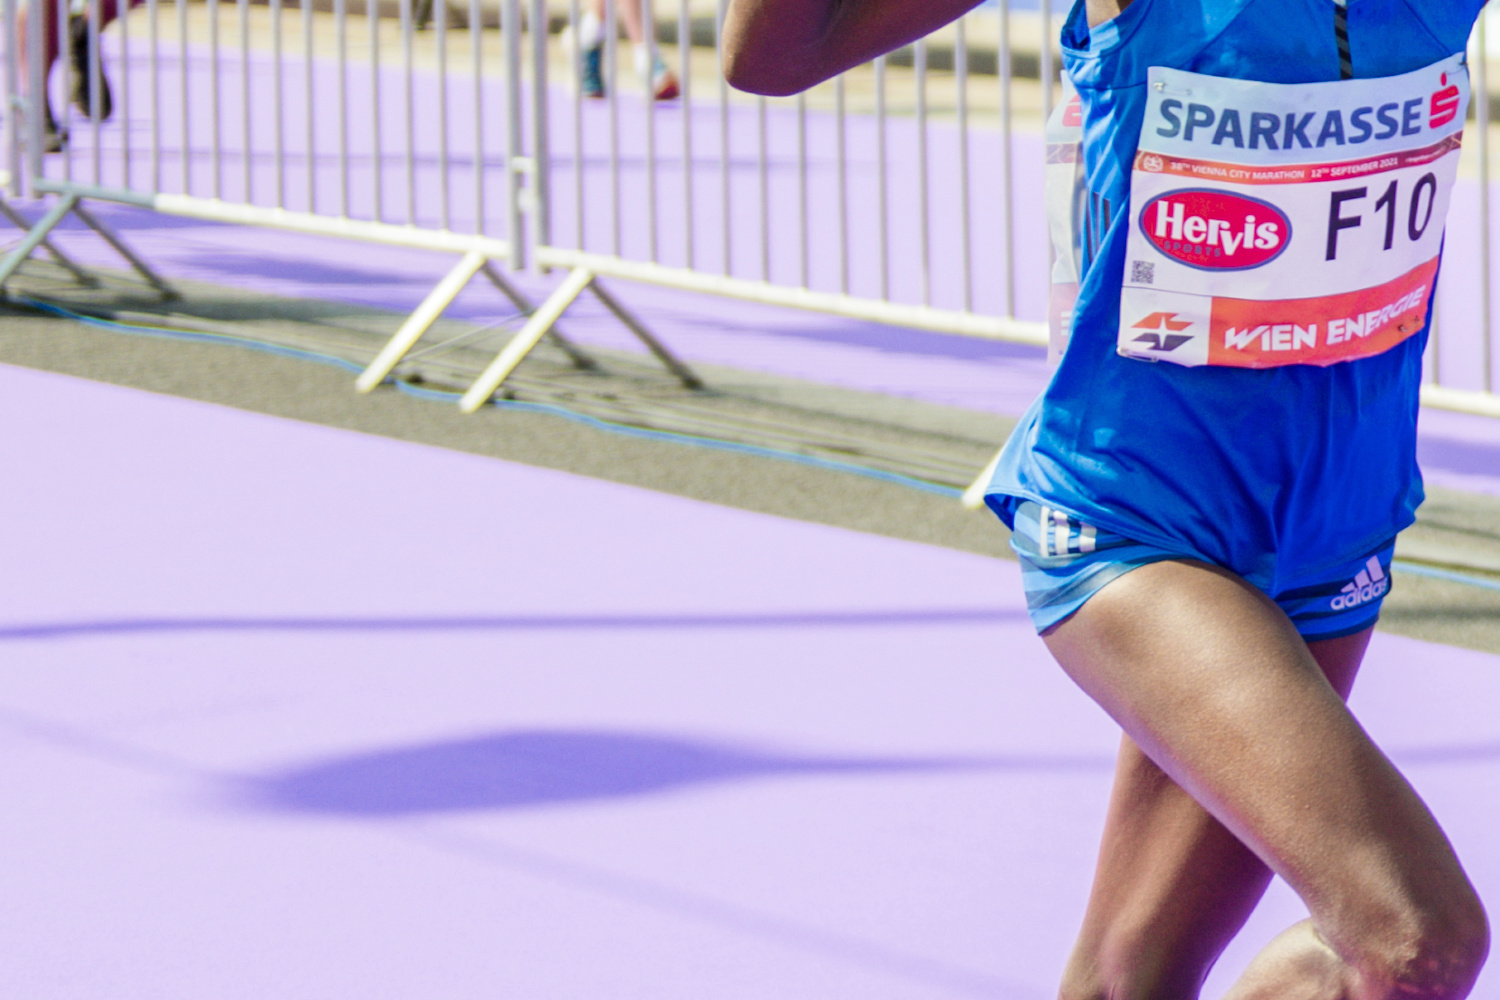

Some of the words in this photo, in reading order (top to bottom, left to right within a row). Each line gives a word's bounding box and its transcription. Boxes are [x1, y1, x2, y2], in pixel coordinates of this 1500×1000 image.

[1156, 97, 1424, 150] SPARKASSE
[1192, 165, 1227, 177] VIENNA
[1229, 169, 1251, 179] CITY
[1252, 169, 1306, 181] MARATHON
[1330, 161, 1380, 177] SEPTEMBER
[1380, 156, 1399, 169] 2021
[1154, 199, 1280, 256] Hervis
[1325, 171, 1438, 262] F10
[1163, 240, 1222, 258] SPORTS
[1224, 323, 1318, 352] WIEN
[1325, 284, 1427, 346] ENERGIE
[1330, 577, 1388, 611] adidas
